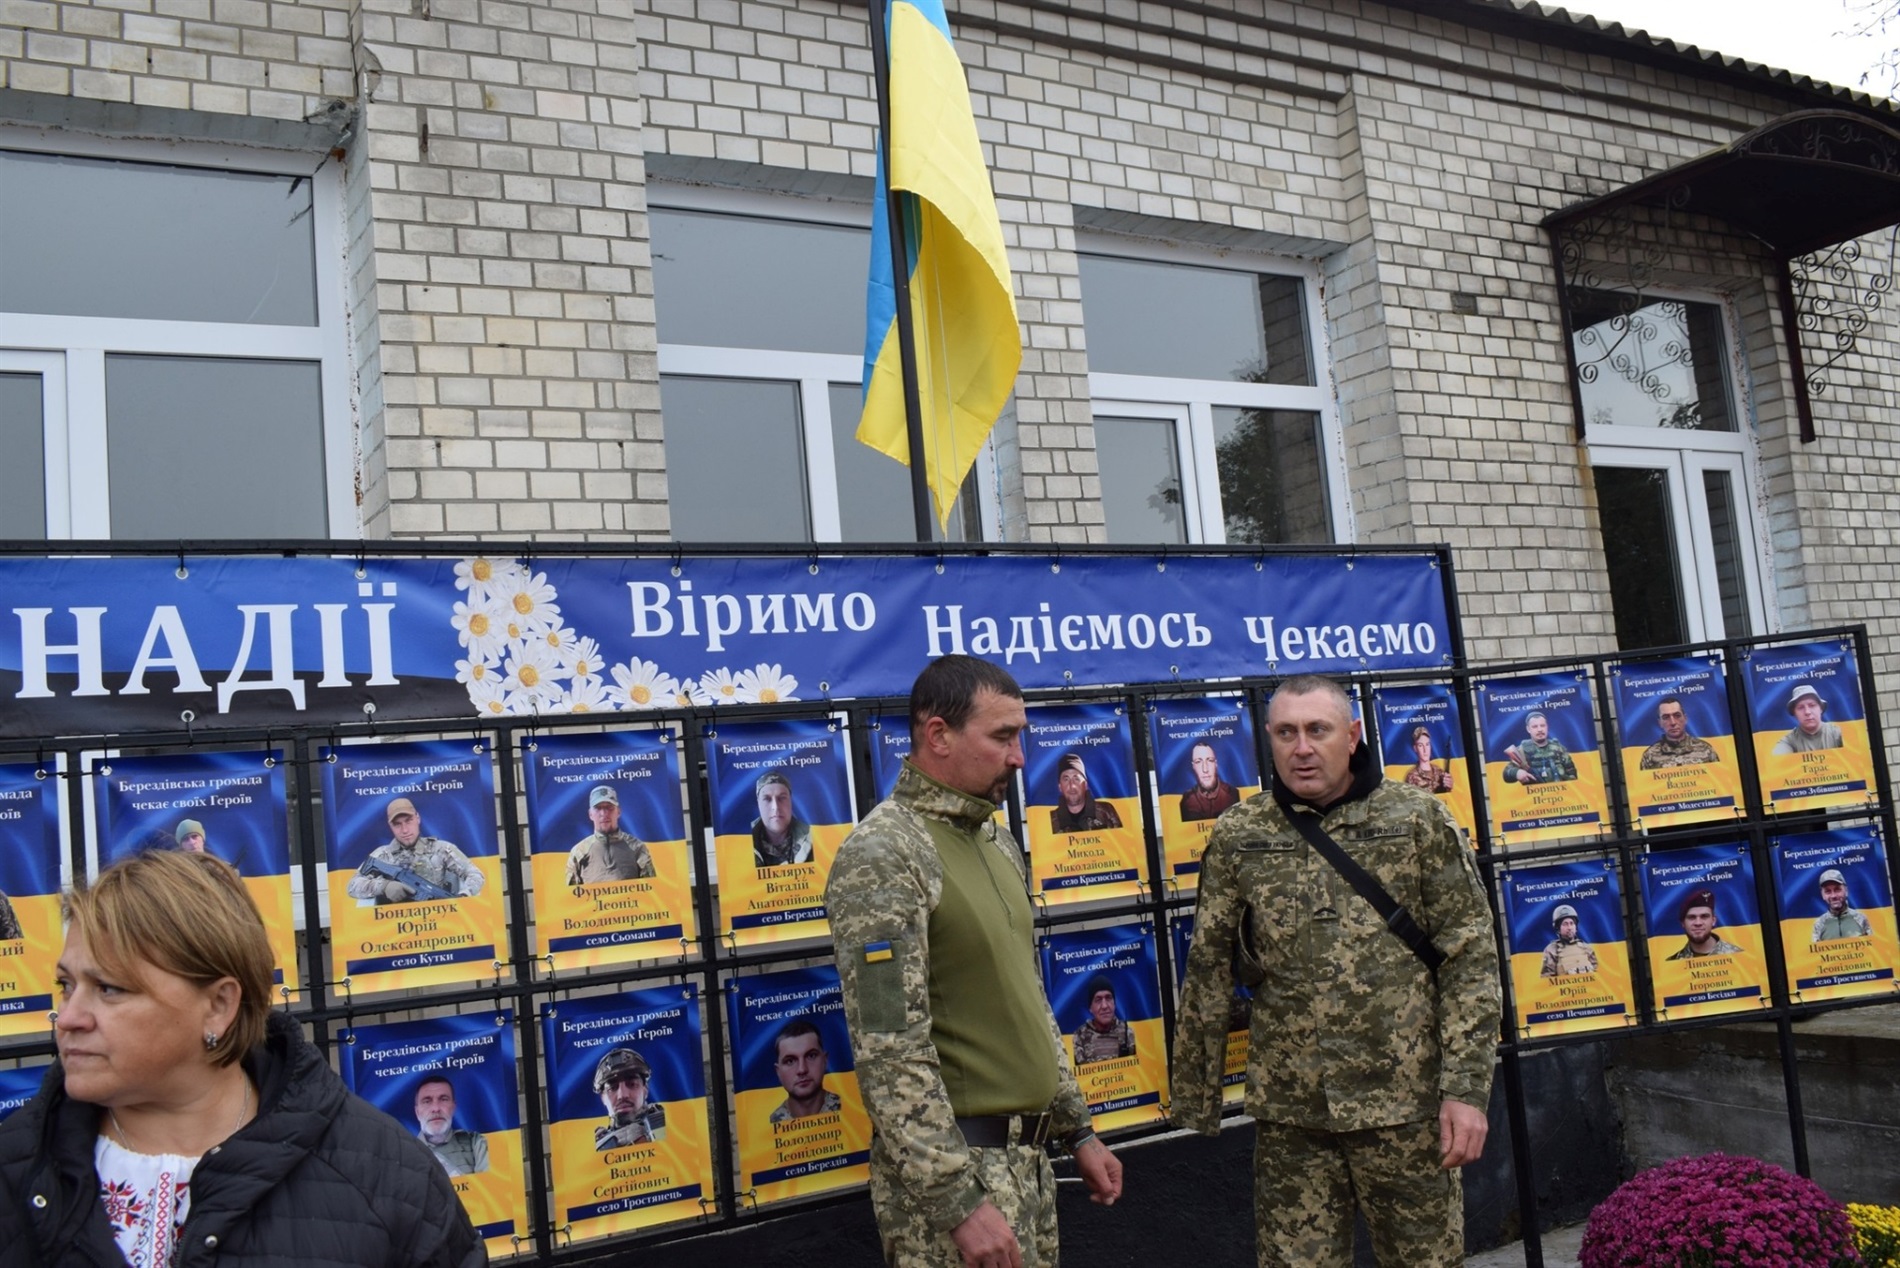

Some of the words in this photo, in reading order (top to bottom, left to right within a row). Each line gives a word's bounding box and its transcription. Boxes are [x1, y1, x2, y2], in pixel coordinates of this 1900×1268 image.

[627, 580, 877, 652] Віримо
[923, 602, 1213, 665] Надіємось
[1244, 614, 1437, 665] Чекаємо
[13, 582, 400, 714] НАДІЇ
[1756, 659, 1807, 672] Берездівська
[1808, 657, 1841, 667] громада
[1624, 675, 1675, 687] Берездівська
[1677, 672, 1709, 683] громада
[1765, 674, 1786, 684] чекає
[1788, 673, 1808, 681] своїх
[1810, 669, 1836, 679] Героїв
[1490, 691, 1541, 703] Берездівська
[1543, 687, 1575, 699] громада
[1634, 690, 1655, 698] чекає
[1657, 688, 1677, 697] своїх
[1679, 684, 1704, 695] Героїв
[1499, 704, 1520, 713] чекає
[1522, 702, 1543, 710] своїх
[1544, 699, 1570, 710] Героїв
[1030, 724, 1082, 735] Берездівська
[1083, 722, 1115, 733] громада
[723, 743, 786, 755] Берездівська
[788, 740, 827, 752] громада
[1038, 738, 1061, 747] чекає
[1062, 737, 1084, 747] своїх
[1085, 734, 1110, 745] Героїв
[543, 756, 613, 770] Берездівська
[616, 751, 659, 766] громада
[733, 760, 760, 770] чекає
[763, 758, 787, 768] своїх
[790, 755, 821, 768] Героїв
[343, 766, 421, 781] Берездівська
[424, 762, 472, 777] громада
[554, 774, 584, 783] чекає
[587, 772, 615, 782] своїх
[617, 770, 652, 783] Героїв
[1653, 767, 1707, 781] Корнійчук
[1802, 764, 1829, 775] Тарас
[119, 779, 205, 794] Берездівська
[210, 776, 262, 790] громада
[1666, 780, 1697, 789] Вадим
[1783, 773, 1849, 787] Анатолійович
[355, 785, 388, 796] чекає
[391, 783, 422, 794] своїх
[425, 781, 463, 794] Героїв
[1526, 784, 1567, 796] Борщук
[1650, 788, 1717, 803] Анатолійович
[1790, 789, 1807, 798] село
[132, 798, 169, 811] чекає
[172, 796, 206, 808] своїх
[210, 794, 252, 808] Героїв
[1533, 796, 1564, 805] Петро
[1510, 804, 1589, 818] Володимирович
[1658, 804, 1675, 813] село
[1518, 819, 1535, 828] село
[1068, 836, 1101, 849] Рудюк
[1067, 848, 1105, 859] Микола
[1784, 846, 1836, 859] Берездівська
[1837, 842, 1869, 854] громада
[1054, 859, 1121, 874] Миколайович
[1652, 863, 1704, 876] Берездівська
[1705, 859, 1738, 871] громада
[1793, 861, 1814, 869] чекає
[1816, 859, 1837, 867] своїх
[1838, 855, 1865, 865] Героїв
[757, 866, 815, 882] Шклярук
[1062, 876, 1078, 886] село
[1080, 872, 1125, 884] Красносілка
[1661, 878, 1683, 887] чекає
[1684, 876, 1705, 884] своїх
[1707, 872, 1732, 883] Героїв
[766, 877, 809, 894] Віталій
[1516, 880, 1569, 892] Берездівська
[1570, 876, 1603, 886] громада
[572, 883, 653, 901] Фурманець
[1525, 895, 1547, 904] чекає
[1549, 892, 1570, 901] своїх
[1572, 889, 1598, 899] Героїв
[593, 898, 638, 913] Леонід
[748, 895, 823, 910] Анатолійови
[374, 903, 458, 921] Бондарчук
[762, 914, 782, 923] село
[784, 909, 824, 921] Берездів
[397, 919, 437, 938] Юрій
[563, 911, 669, 931] Володимирович
[361, 934, 475, 954] Олександрович
[586, 936, 609, 946] село
[611, 931, 656, 942] Сьомаки
[1055, 947, 1107, 962] Берездівська
[1109, 942, 1141, 956] громада
[1820, 951, 1864, 964] Михайло
[392, 957, 417, 967] село
[420, 953, 453, 967] Кутки
[1063, 965, 1086, 975] чекає
[1087, 962, 1108, 972] своїх
[1110, 957, 1135, 969] Героїв
[1691, 969, 1729, 979] Максим
[1816, 961, 1872, 976] Леонідович
[1690, 979, 1733, 991] Ігорович
[1815, 977, 1831, 986] село
[1832, 972, 1876, 985] Тростянець
[745, 990, 809, 1008] Берездівська
[811, 984, 841, 999] грома
[1560, 986, 1587, 997] Юрій
[1689, 994, 1706, 1002] село
[1535, 995, 1614, 1010] Володимирович
[755, 1011, 782, 1022] чекає
[785, 1006, 810, 1017] своїх
[812, 1001, 843, 1015] Героїв
[1547, 1012, 1564, 1020] село
[562, 1015, 633, 1033] Берездівська
[637, 1008, 681, 1025] громада
[574, 1036, 604, 1048] чекає
[607, 1032, 635, 1043] своїх
[638, 1026, 673, 1040] Героїв
[363, 1043, 441, 1061] Берездівська
[445, 1035, 493, 1050] громада
[375, 1065, 409, 1077] чекає
[412, 1061, 443, 1072] своїх
[446, 1054, 485, 1069] Героїв
[1091, 1073, 1124, 1087] Сергій
[773, 1111, 841, 1136] Рибіцький
[775, 1129, 842, 1149] Володимир
[604, 1148, 655, 1165] Санчук
[774, 1144, 844, 1164] Леонідович
[610, 1165, 651, 1181] Вадим
[785, 1166, 806, 1176] село
[808, 1157, 848, 1174] Берездів
[593, 1177, 670, 1201] Сергійович
[597, 1203, 620, 1213] село
[621, 1191, 682, 1210] Тростянець
